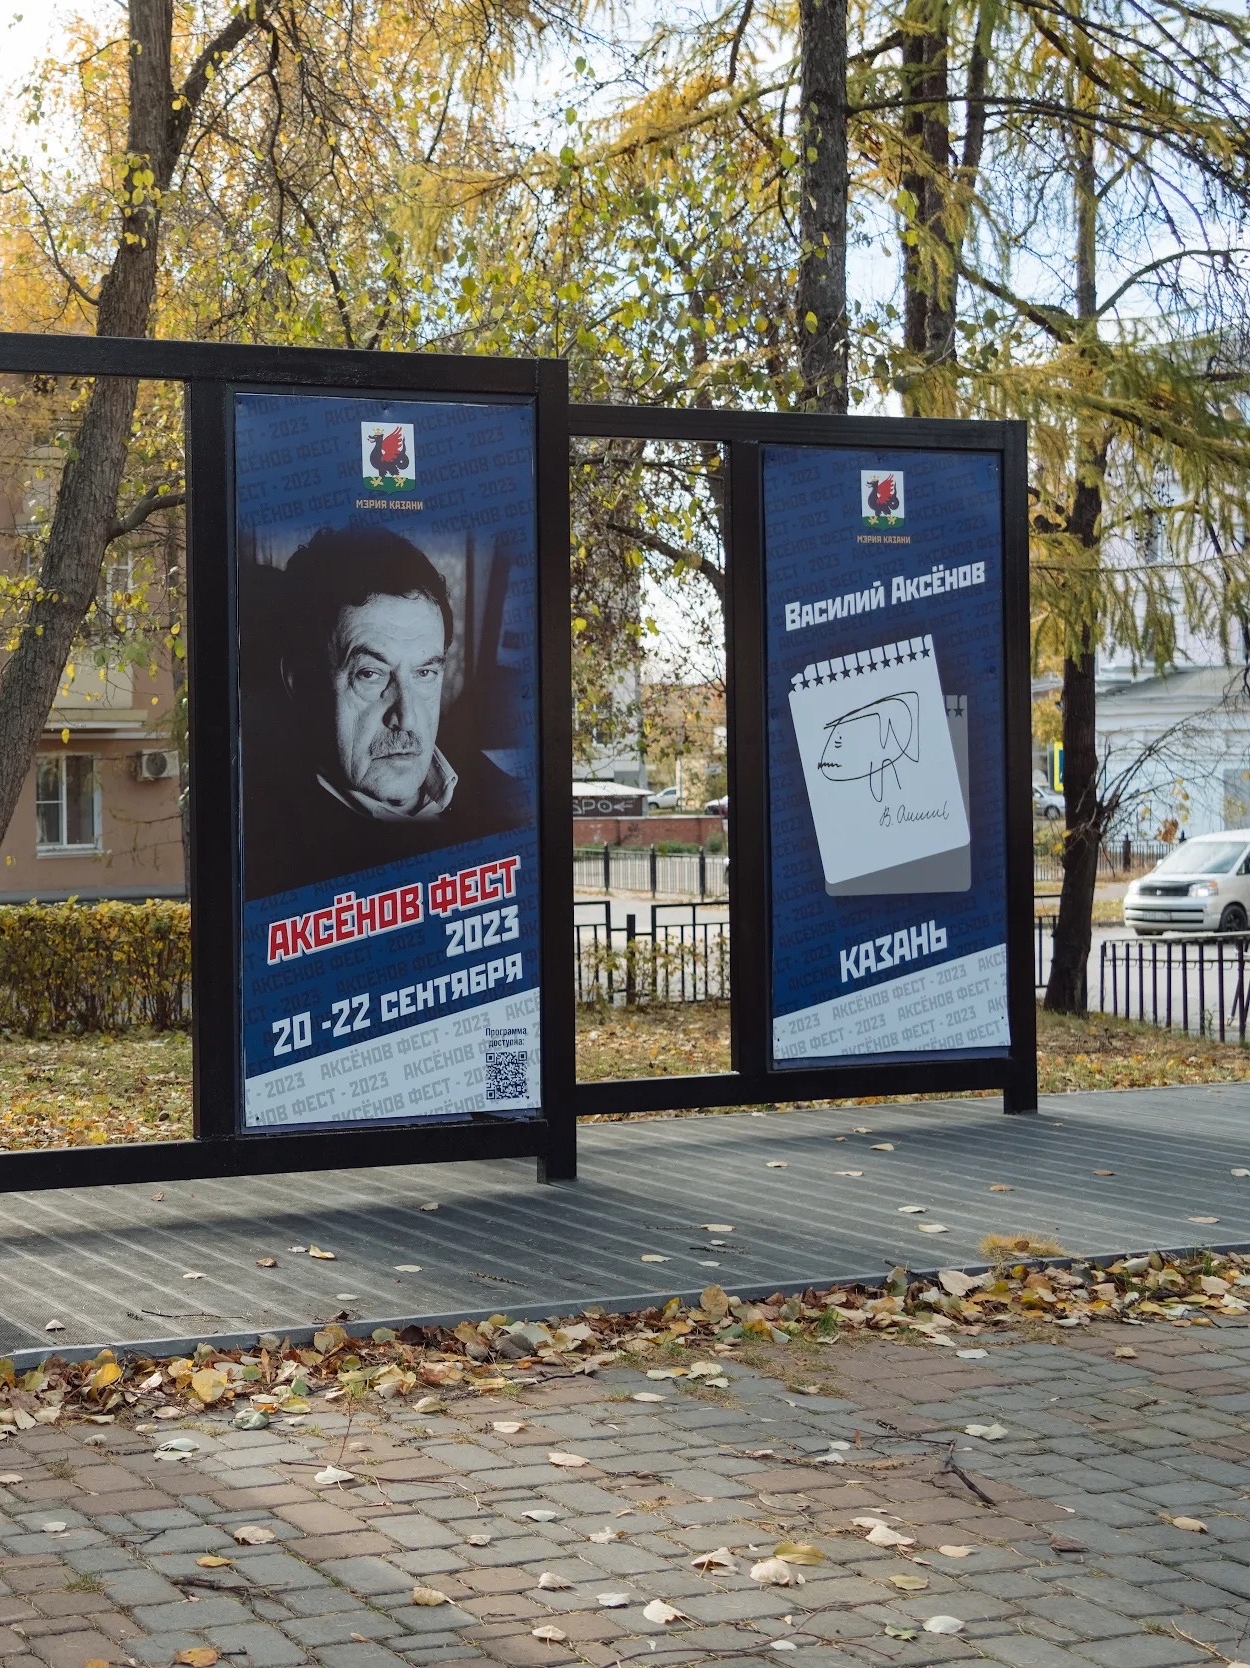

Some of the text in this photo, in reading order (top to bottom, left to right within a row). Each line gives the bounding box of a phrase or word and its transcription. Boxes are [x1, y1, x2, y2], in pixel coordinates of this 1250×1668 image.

[356, 499, 424, 510] МЭРИЯ КАЗАНИ
[857, 535, 911, 545] МЭРИЯ КАЗАНИ
[268, 882, 425, 966] АКСЁНОВ
[428, 855, 521, 918] ФЕСТ
[445, 904, 520, 958] 2023
[839, 919, 948, 983] КАЗАНЬ
[272, 1011, 312, 1057] 20
[380, 952, 523, 1022] СЕНТЯБРЯ
[788, 1012, 821, 1036] 2023
[831, 989, 890, 1021] АКСЁНОВ
[892, 976, 926, 1000] ФЕСТ
[936, 963, 967, 986] 2023
[810, 1026, 844, 1050] ФЕСТ
[855, 1012, 886, 1036] 2023
[896, 990, 954, 1021] АКСЁНОВ
[956, 978, 990, 1001] ФЕСТ
[901, 1019, 935, 1042] ФЕСТ
[946, 1005, 976, 1027] 2023
[265, 1071, 306, 1099] 2023
[320, 1043, 394, 1081] АКСЁНОВ
[397, 1027, 440, 1057] ФЕСТ
[453, 1012, 491, 1037] 2023
[485, 1027, 528, 1039] Программа
[966, 1019, 1001, 1042] ФЕСТ
[292, 1087, 336, 1116] ФЕСТ
[349, 1071, 390, 1098] 2023
[403, 1048, 476, 1081] АКСЁНОВ
[408, 1078, 452, 1105] ФЕСТ
